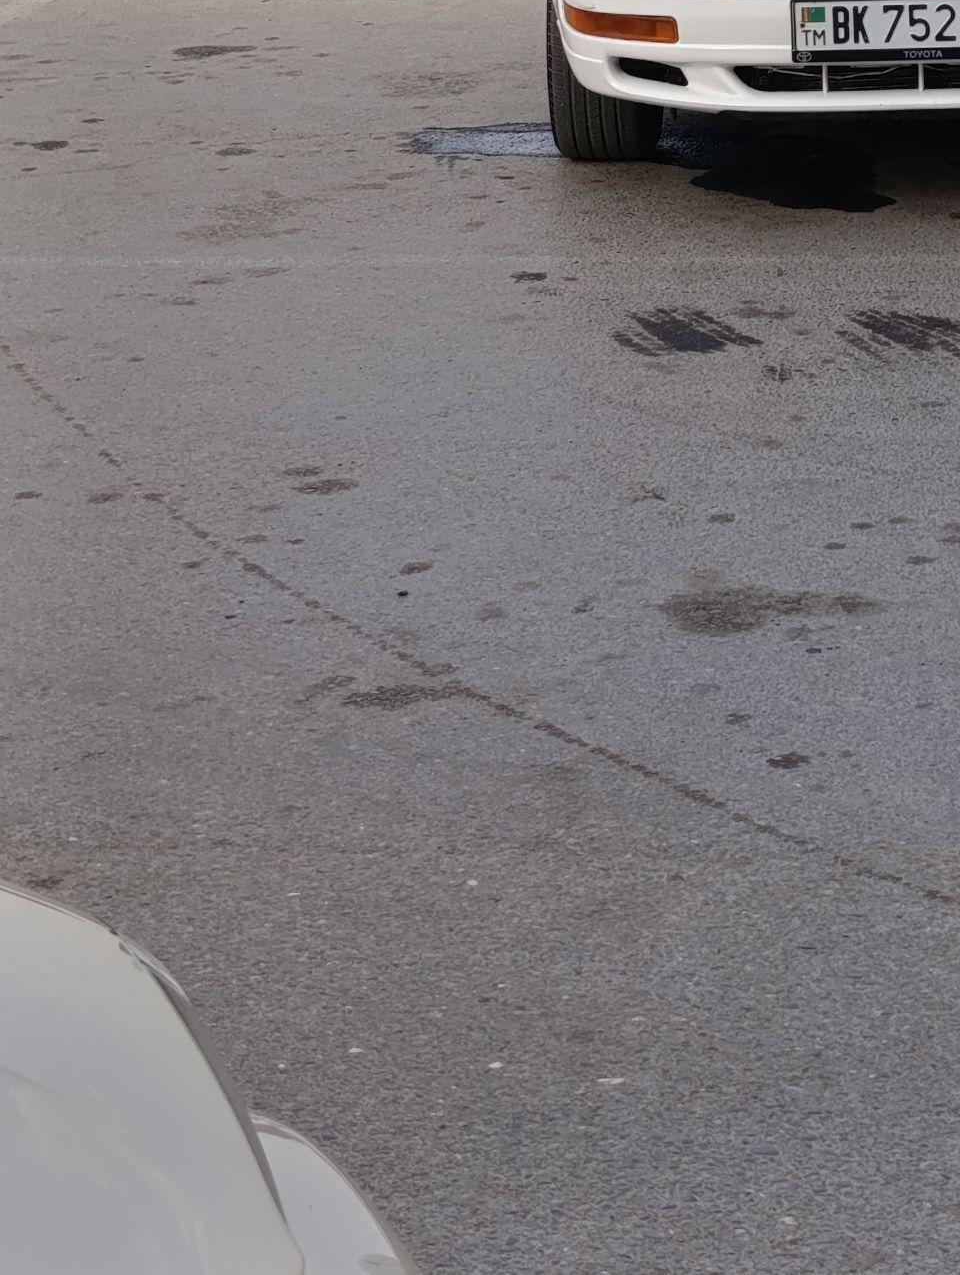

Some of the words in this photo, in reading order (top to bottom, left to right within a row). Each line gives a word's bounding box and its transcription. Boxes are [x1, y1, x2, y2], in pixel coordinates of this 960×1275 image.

[832, 5, 870, 44] BK
[801, 29, 826, 46] TM
[903, 50, 944, 58] TOYOTA
